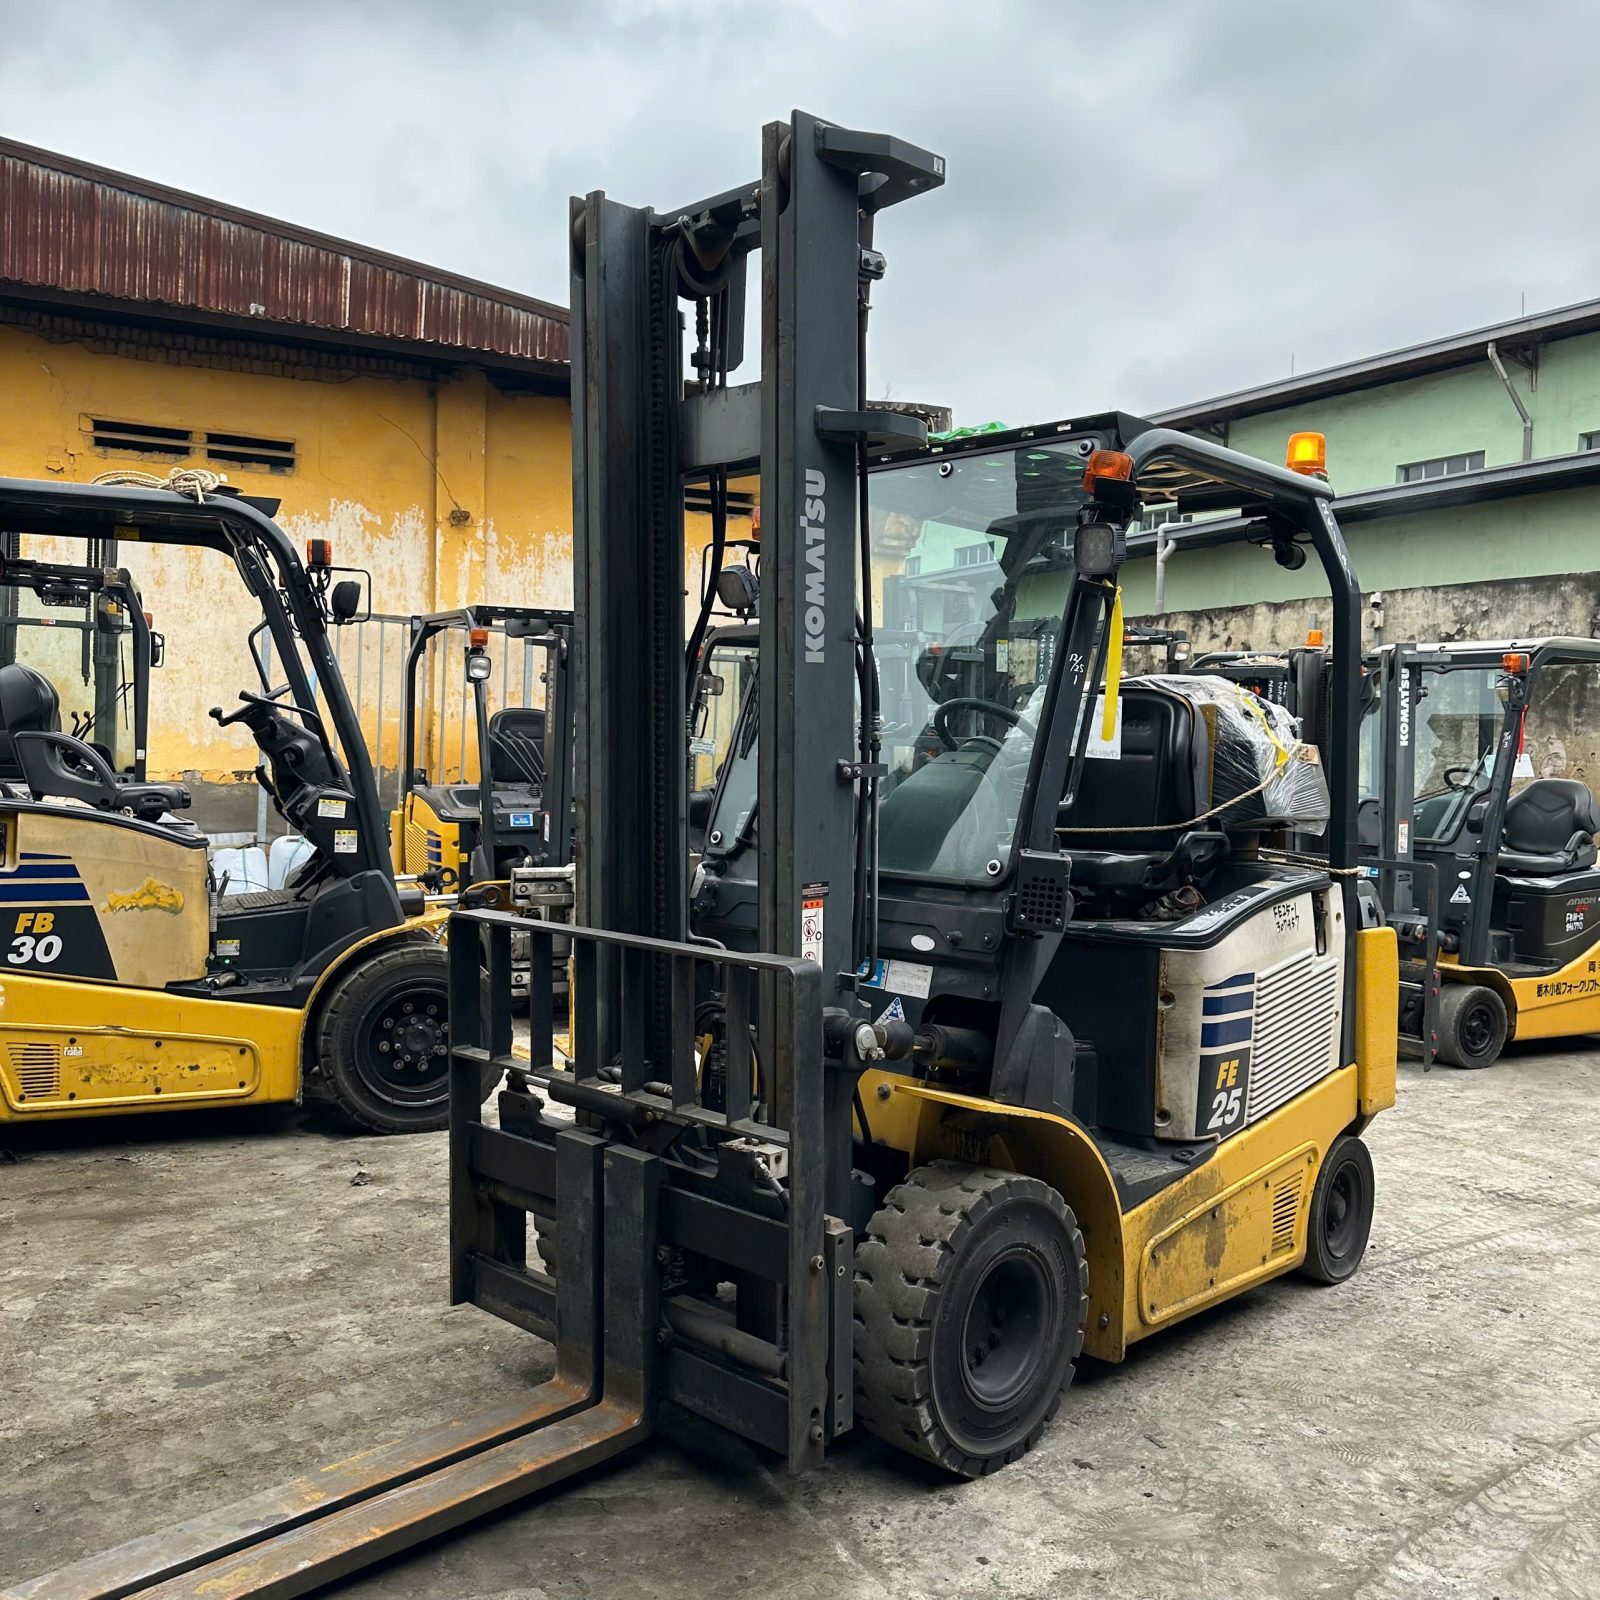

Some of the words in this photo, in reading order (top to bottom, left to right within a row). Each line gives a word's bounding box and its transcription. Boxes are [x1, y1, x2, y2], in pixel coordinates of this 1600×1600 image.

[800, 468, 826, 664] KOMATSU
[1399, 668, 1410, 747] KOMATSU
[15, 912, 55, 934] FB
[7, 935, 63, 964] 30
[1215, 1059, 1240, 1089] FE
[1207, 1087, 1243, 1129] 25
